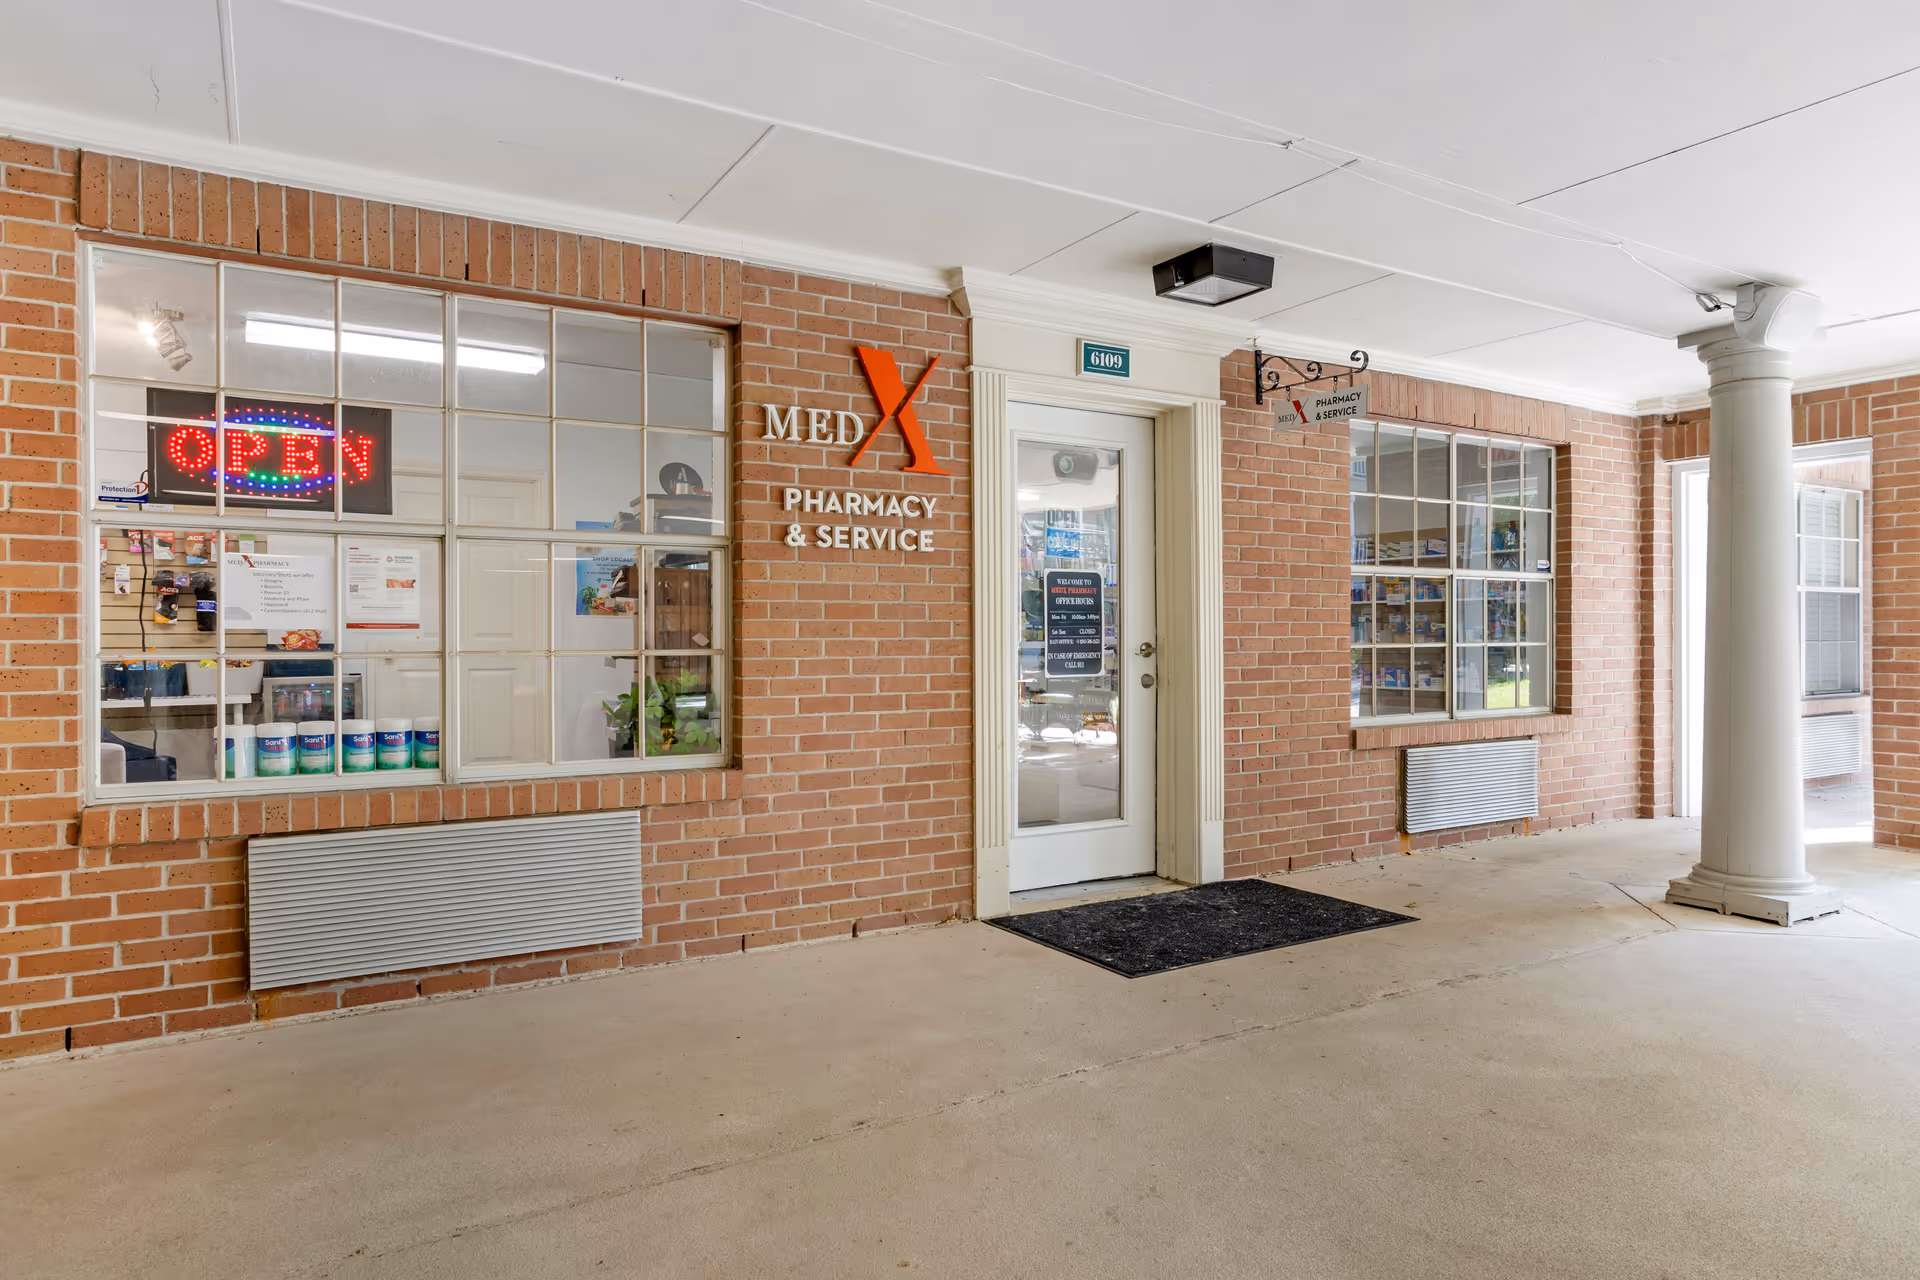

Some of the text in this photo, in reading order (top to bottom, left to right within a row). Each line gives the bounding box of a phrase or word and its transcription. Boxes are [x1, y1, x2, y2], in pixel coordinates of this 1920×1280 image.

[1090, 351, 1122, 369] 6109
[1316, 391, 1362, 408] PHARMACY
[1315, 405, 1357, 421] & SERVICE
[167, 428, 374, 481] OPEN
[783, 487, 937, 519] PHARMACY
[784, 523, 935, 553] & SERVICE
[1056, 578, 1083, 586] WELCOME
[1055, 597, 1094, 605] OFFICE HOURS
